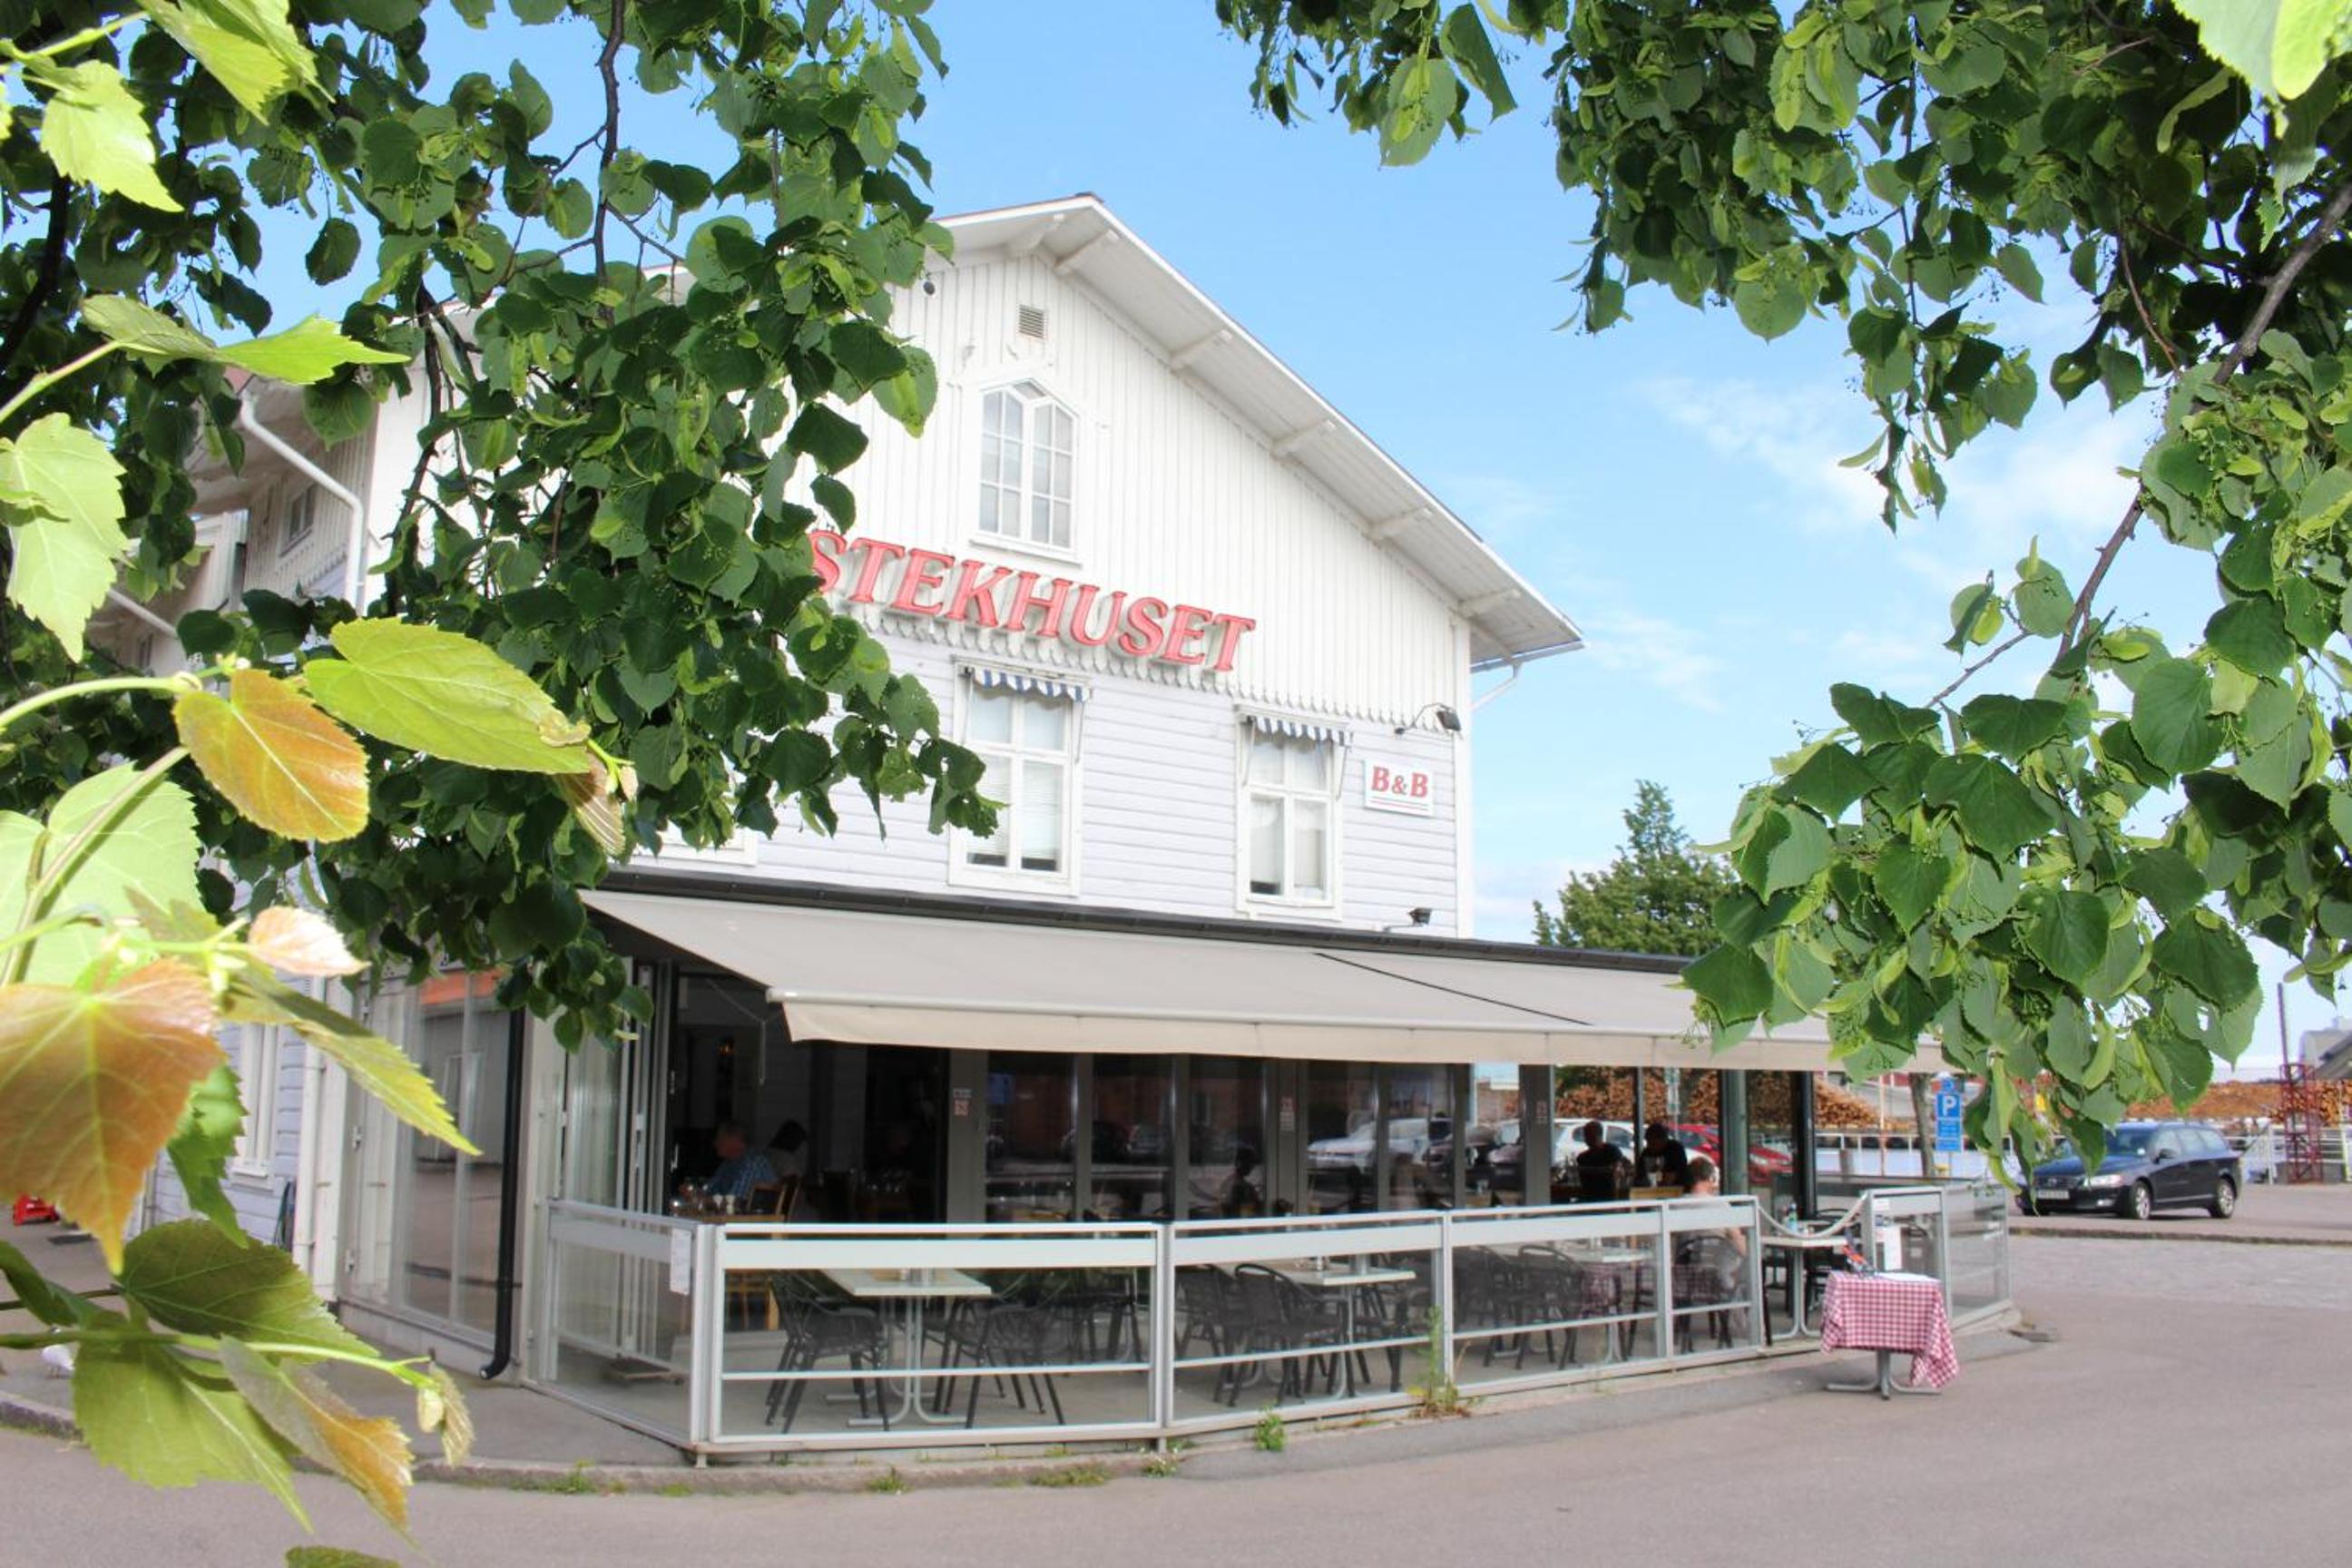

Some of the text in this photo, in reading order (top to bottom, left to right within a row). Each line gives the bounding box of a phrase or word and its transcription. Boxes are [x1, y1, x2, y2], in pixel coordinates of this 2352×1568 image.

[808, 529, 1256, 671] STEKHUSET
[1371, 765, 1428, 799] B&B
[1943, 1095, 1957, 1116] P
